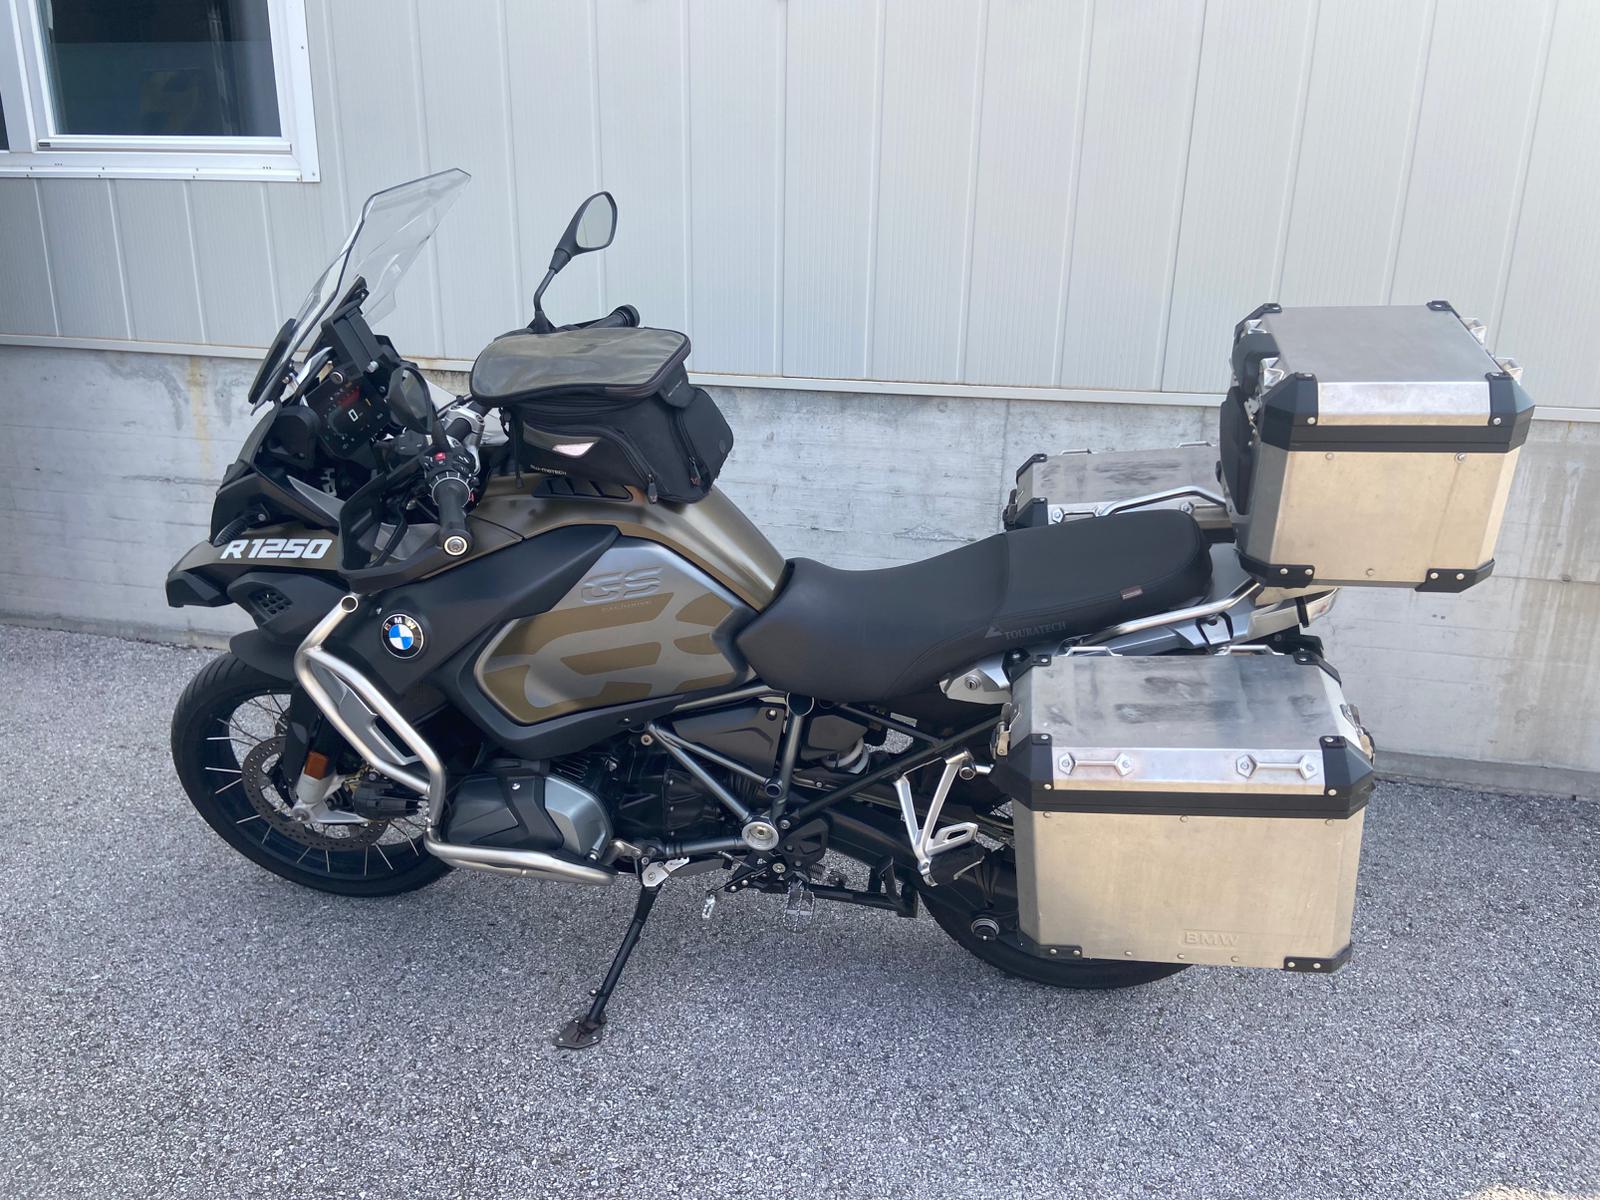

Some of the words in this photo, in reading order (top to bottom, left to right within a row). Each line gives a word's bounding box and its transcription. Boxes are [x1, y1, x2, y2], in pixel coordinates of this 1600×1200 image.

[581, 566, 663, 604] GS
[383, 616, 417, 631] BMW
[1004, 621, 1067, 641] TOURATECH
[1184, 931, 1240, 946] BMW
